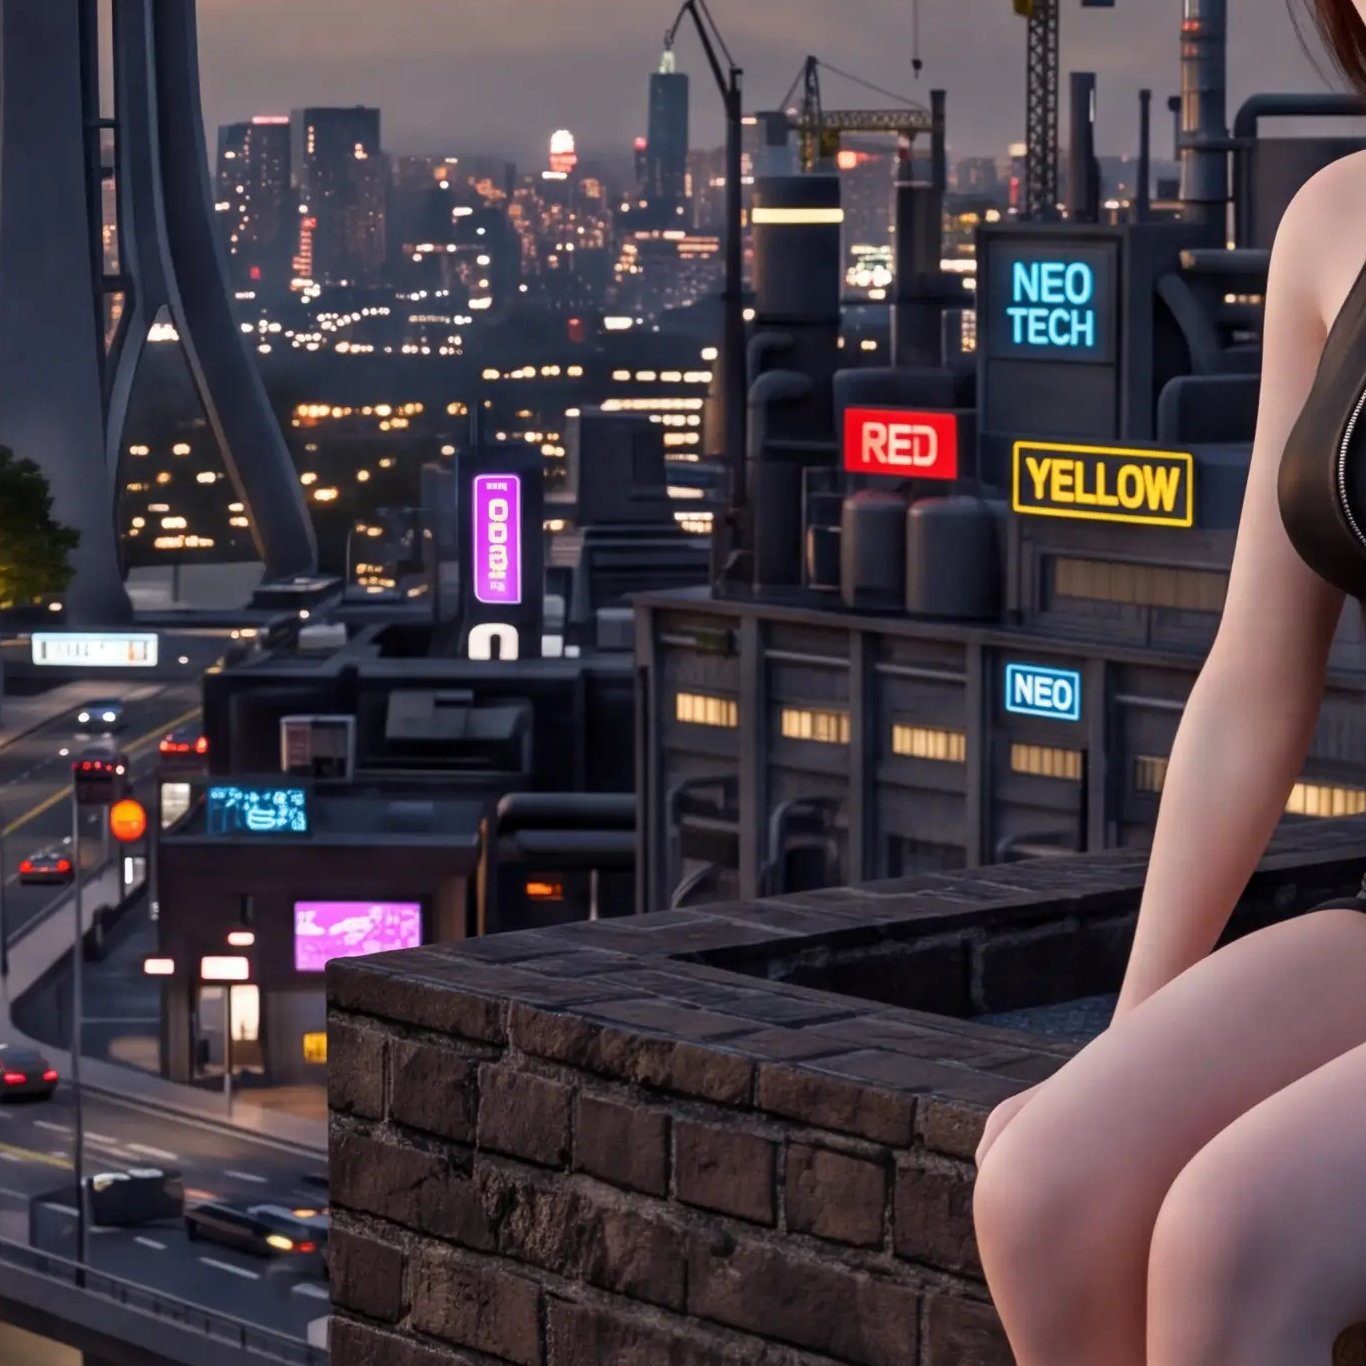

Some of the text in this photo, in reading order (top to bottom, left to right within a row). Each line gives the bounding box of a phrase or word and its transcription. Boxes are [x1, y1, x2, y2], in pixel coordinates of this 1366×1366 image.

[1012, 261, 1093, 305] NEO
[1006, 306, 1095, 348] TECH
[861, 421, 938, 468] RED
[1025, 456, 1181, 513] YELLOW
[1013, 672, 1073, 711] NEO
